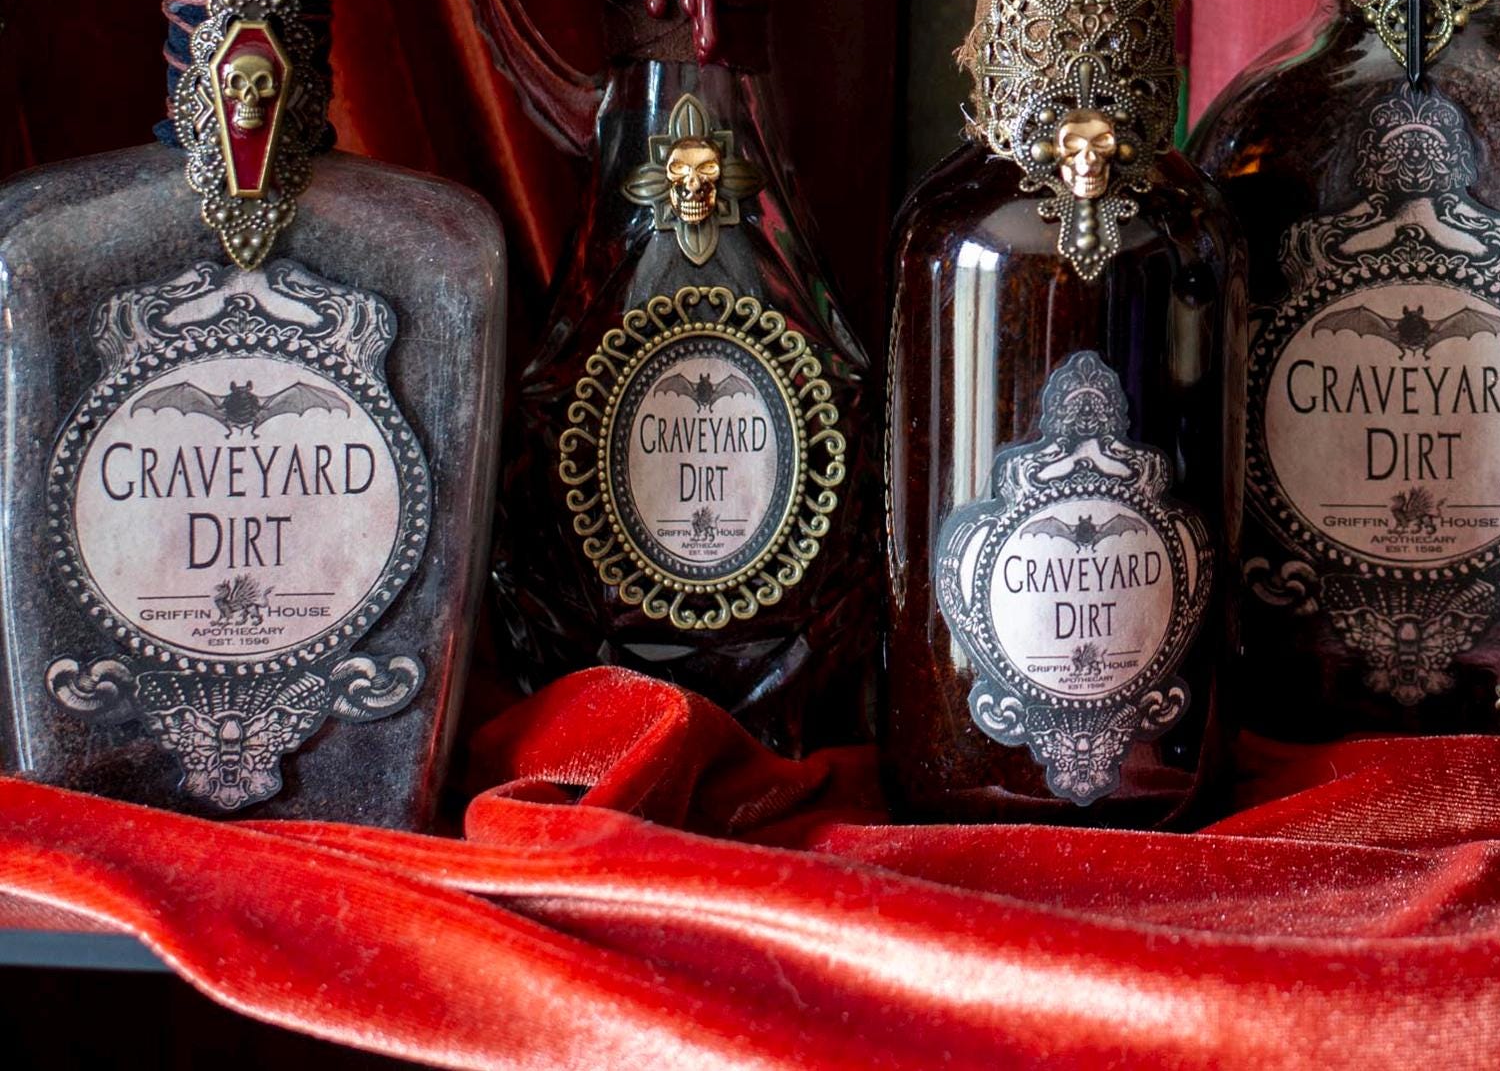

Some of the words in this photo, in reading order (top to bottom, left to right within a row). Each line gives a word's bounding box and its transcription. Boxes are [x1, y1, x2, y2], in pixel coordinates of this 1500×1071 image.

[639, 414, 767, 454] GRAVEYARD
[1365, 427, 1462, 481] DIRT
[101, 442, 376, 502] GRAVEYARD
[680, 463, 728, 503] DIRT
[1323, 516, 1389, 528] GRIFFIN
[1439, 517, 1499, 528] HOUSE
[187, 512, 292, 570] DIRT
[656, 528, 692, 538] GRIFFIN
[716, 528, 746, 538] HOUSE
[1370, 533, 1457, 544] APOTHECARY
[1385, 545, 1411, 554] EST.
[1004, 551, 1162, 593] GRAVEYARD
[139, 606, 212, 621] GRIFFIN
[267, 605, 332, 619] HOUSE
[1055, 602, 1116, 640] DIRT
[192, 626, 285, 638] APOTHECARY
[207, 637, 236, 647] EST.
[239, 636, 271, 646] 1596
[1027, 664, 1071, 674] GRIFFIN
[1103, 660, 1139, 670] HOUSE
